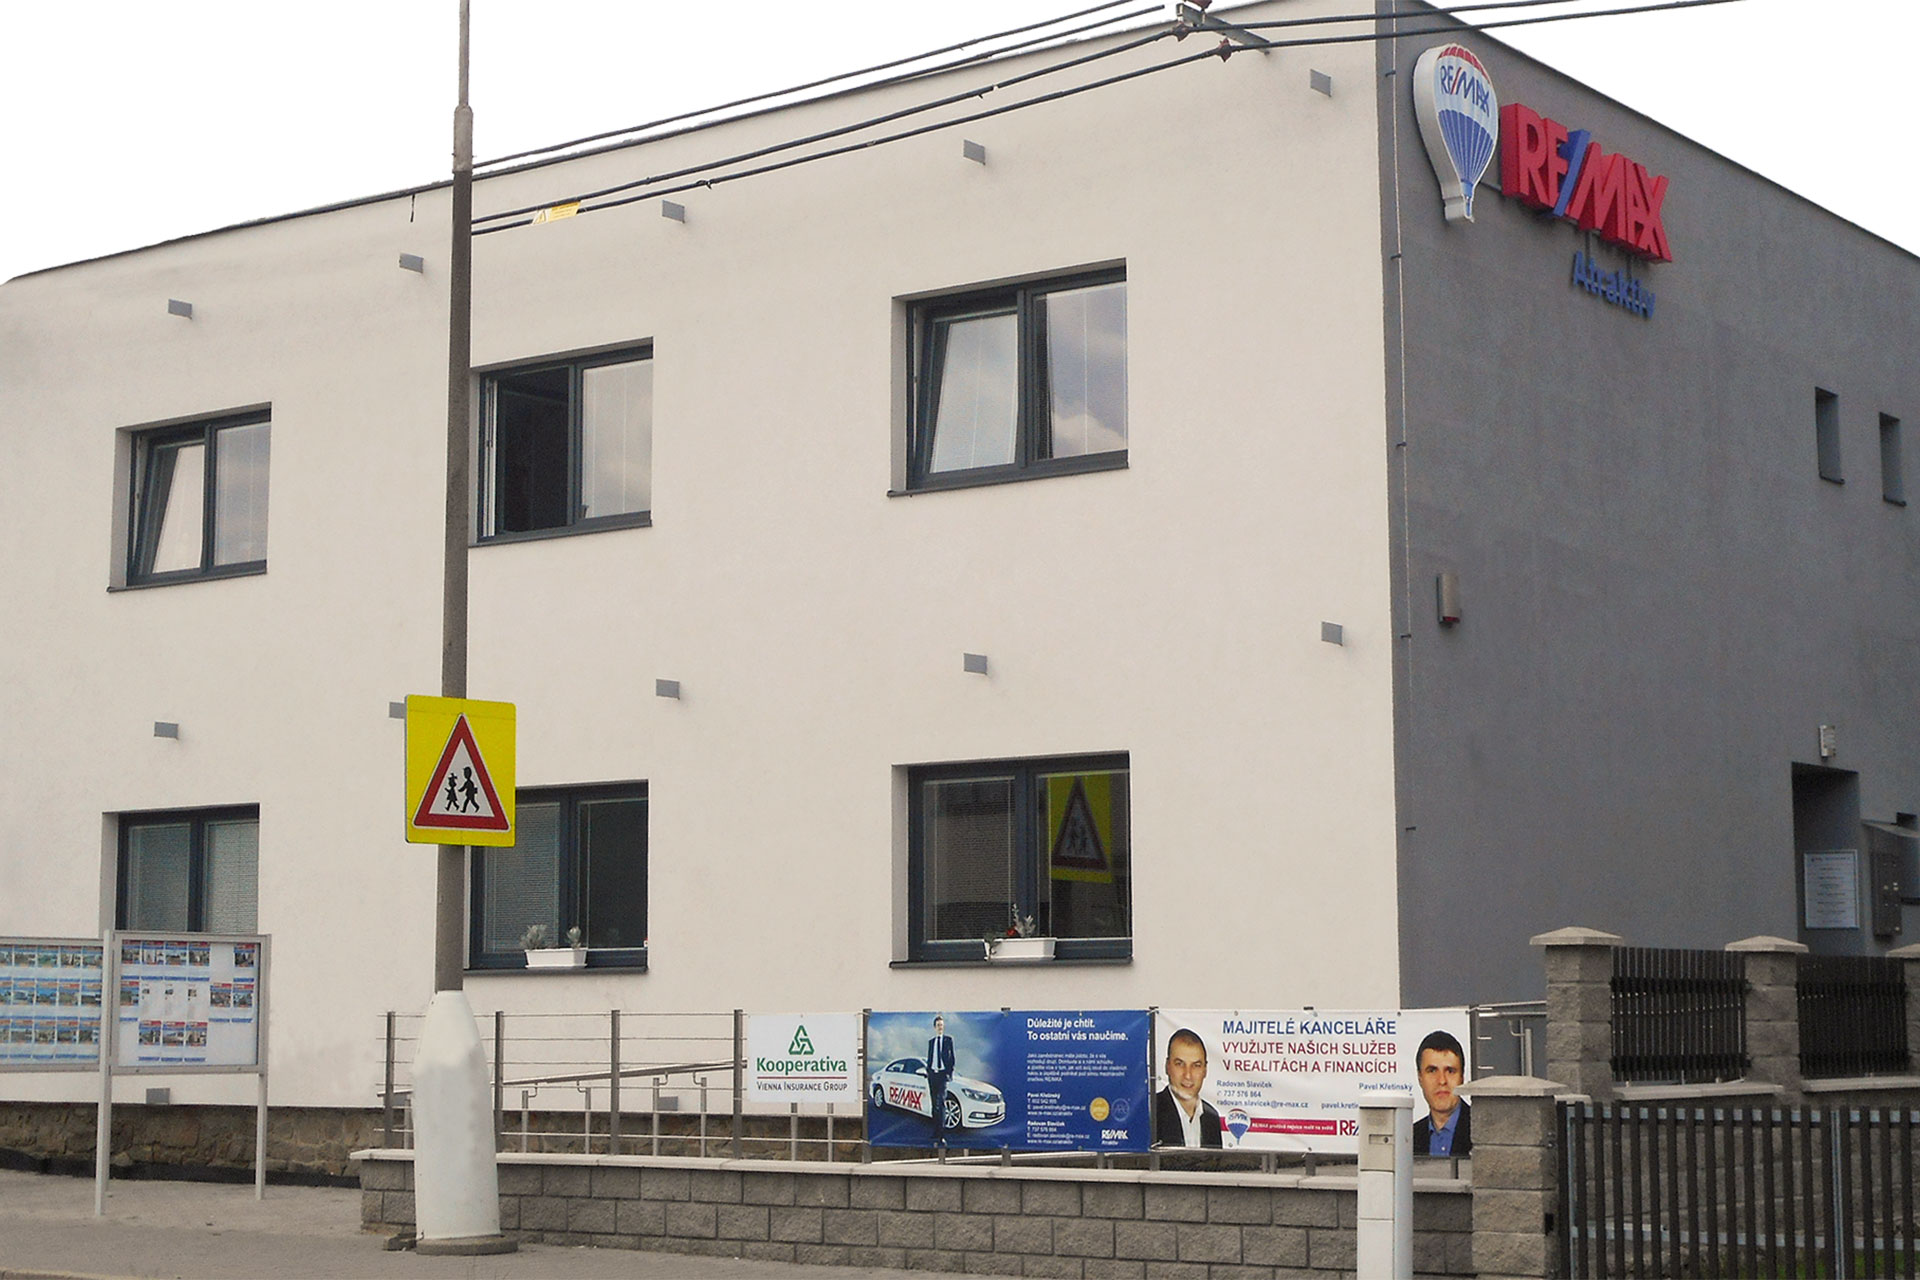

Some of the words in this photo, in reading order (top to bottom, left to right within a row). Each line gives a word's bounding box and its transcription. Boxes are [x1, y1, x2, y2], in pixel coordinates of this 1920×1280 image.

[1440, 65, 1490, 118] RE/MAX
[1501, 103, 1673, 264] RE/MAX
[1572, 250, 1657, 319] Atraktiv
[1026, 1017, 1063, 1028] Důležité
[1063, 1019, 1072, 1031] je
[1222, 1017, 1295, 1035] MAJITELÉ
[1300, 1017, 1397, 1035] KANCELÁŘE
[1026, 1030, 1038, 1041] To
[1071, 1030, 1087, 1041] vás
[1222, 1039, 1284, 1055] VYUŽIJTE
[1287, 1039, 1339, 1055] NAŠICH
[1342, 1040, 1397, 1055] SLUŽEB
[756, 1056, 848, 1076] Kooperativa
[1222, 1059, 1231, 1072] V
[1234, 1057, 1308, 1073] REALITÁCH
[1311, 1061, 1321, 1073] A
[1324, 1059, 1397, 1074] FINANCÍCH
[756, 1081, 782, 1092] VIENNA
[783, 1081, 822, 1092] INSURANCE
[823, 1081, 848, 1092] GROUP
[1216, 1079, 1245, 1088] Radovan
[1358, 1082, 1378, 1090] Pavel
[889, 1086, 923, 1111] RE/MAX
[1101, 1129, 1129, 1140] RE/MAX
